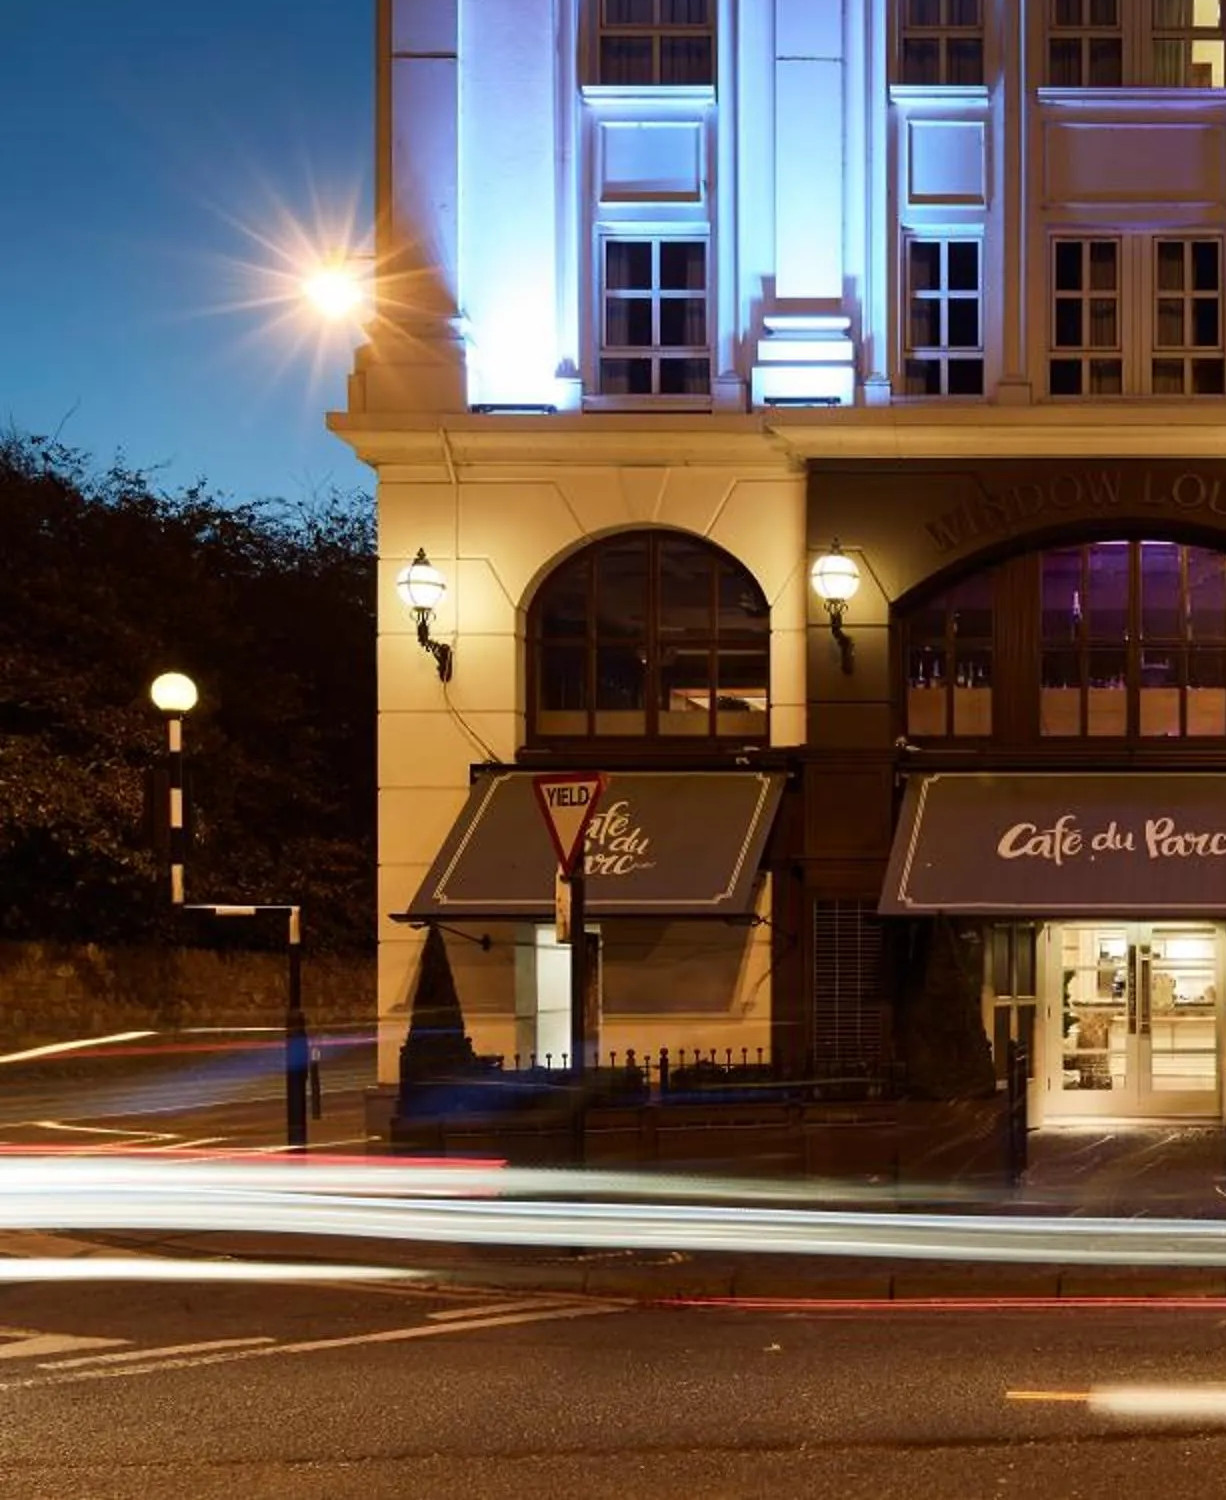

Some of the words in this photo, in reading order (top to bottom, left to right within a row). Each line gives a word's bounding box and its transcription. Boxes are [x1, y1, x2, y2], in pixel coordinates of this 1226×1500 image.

[923, 471, 1121, 552] WINDOW
[547, 786, 590, 808] YIELD
[585, 801, 630, 845] afé
[1091, 821, 1137, 852] du
[608, 827, 649, 854] du
